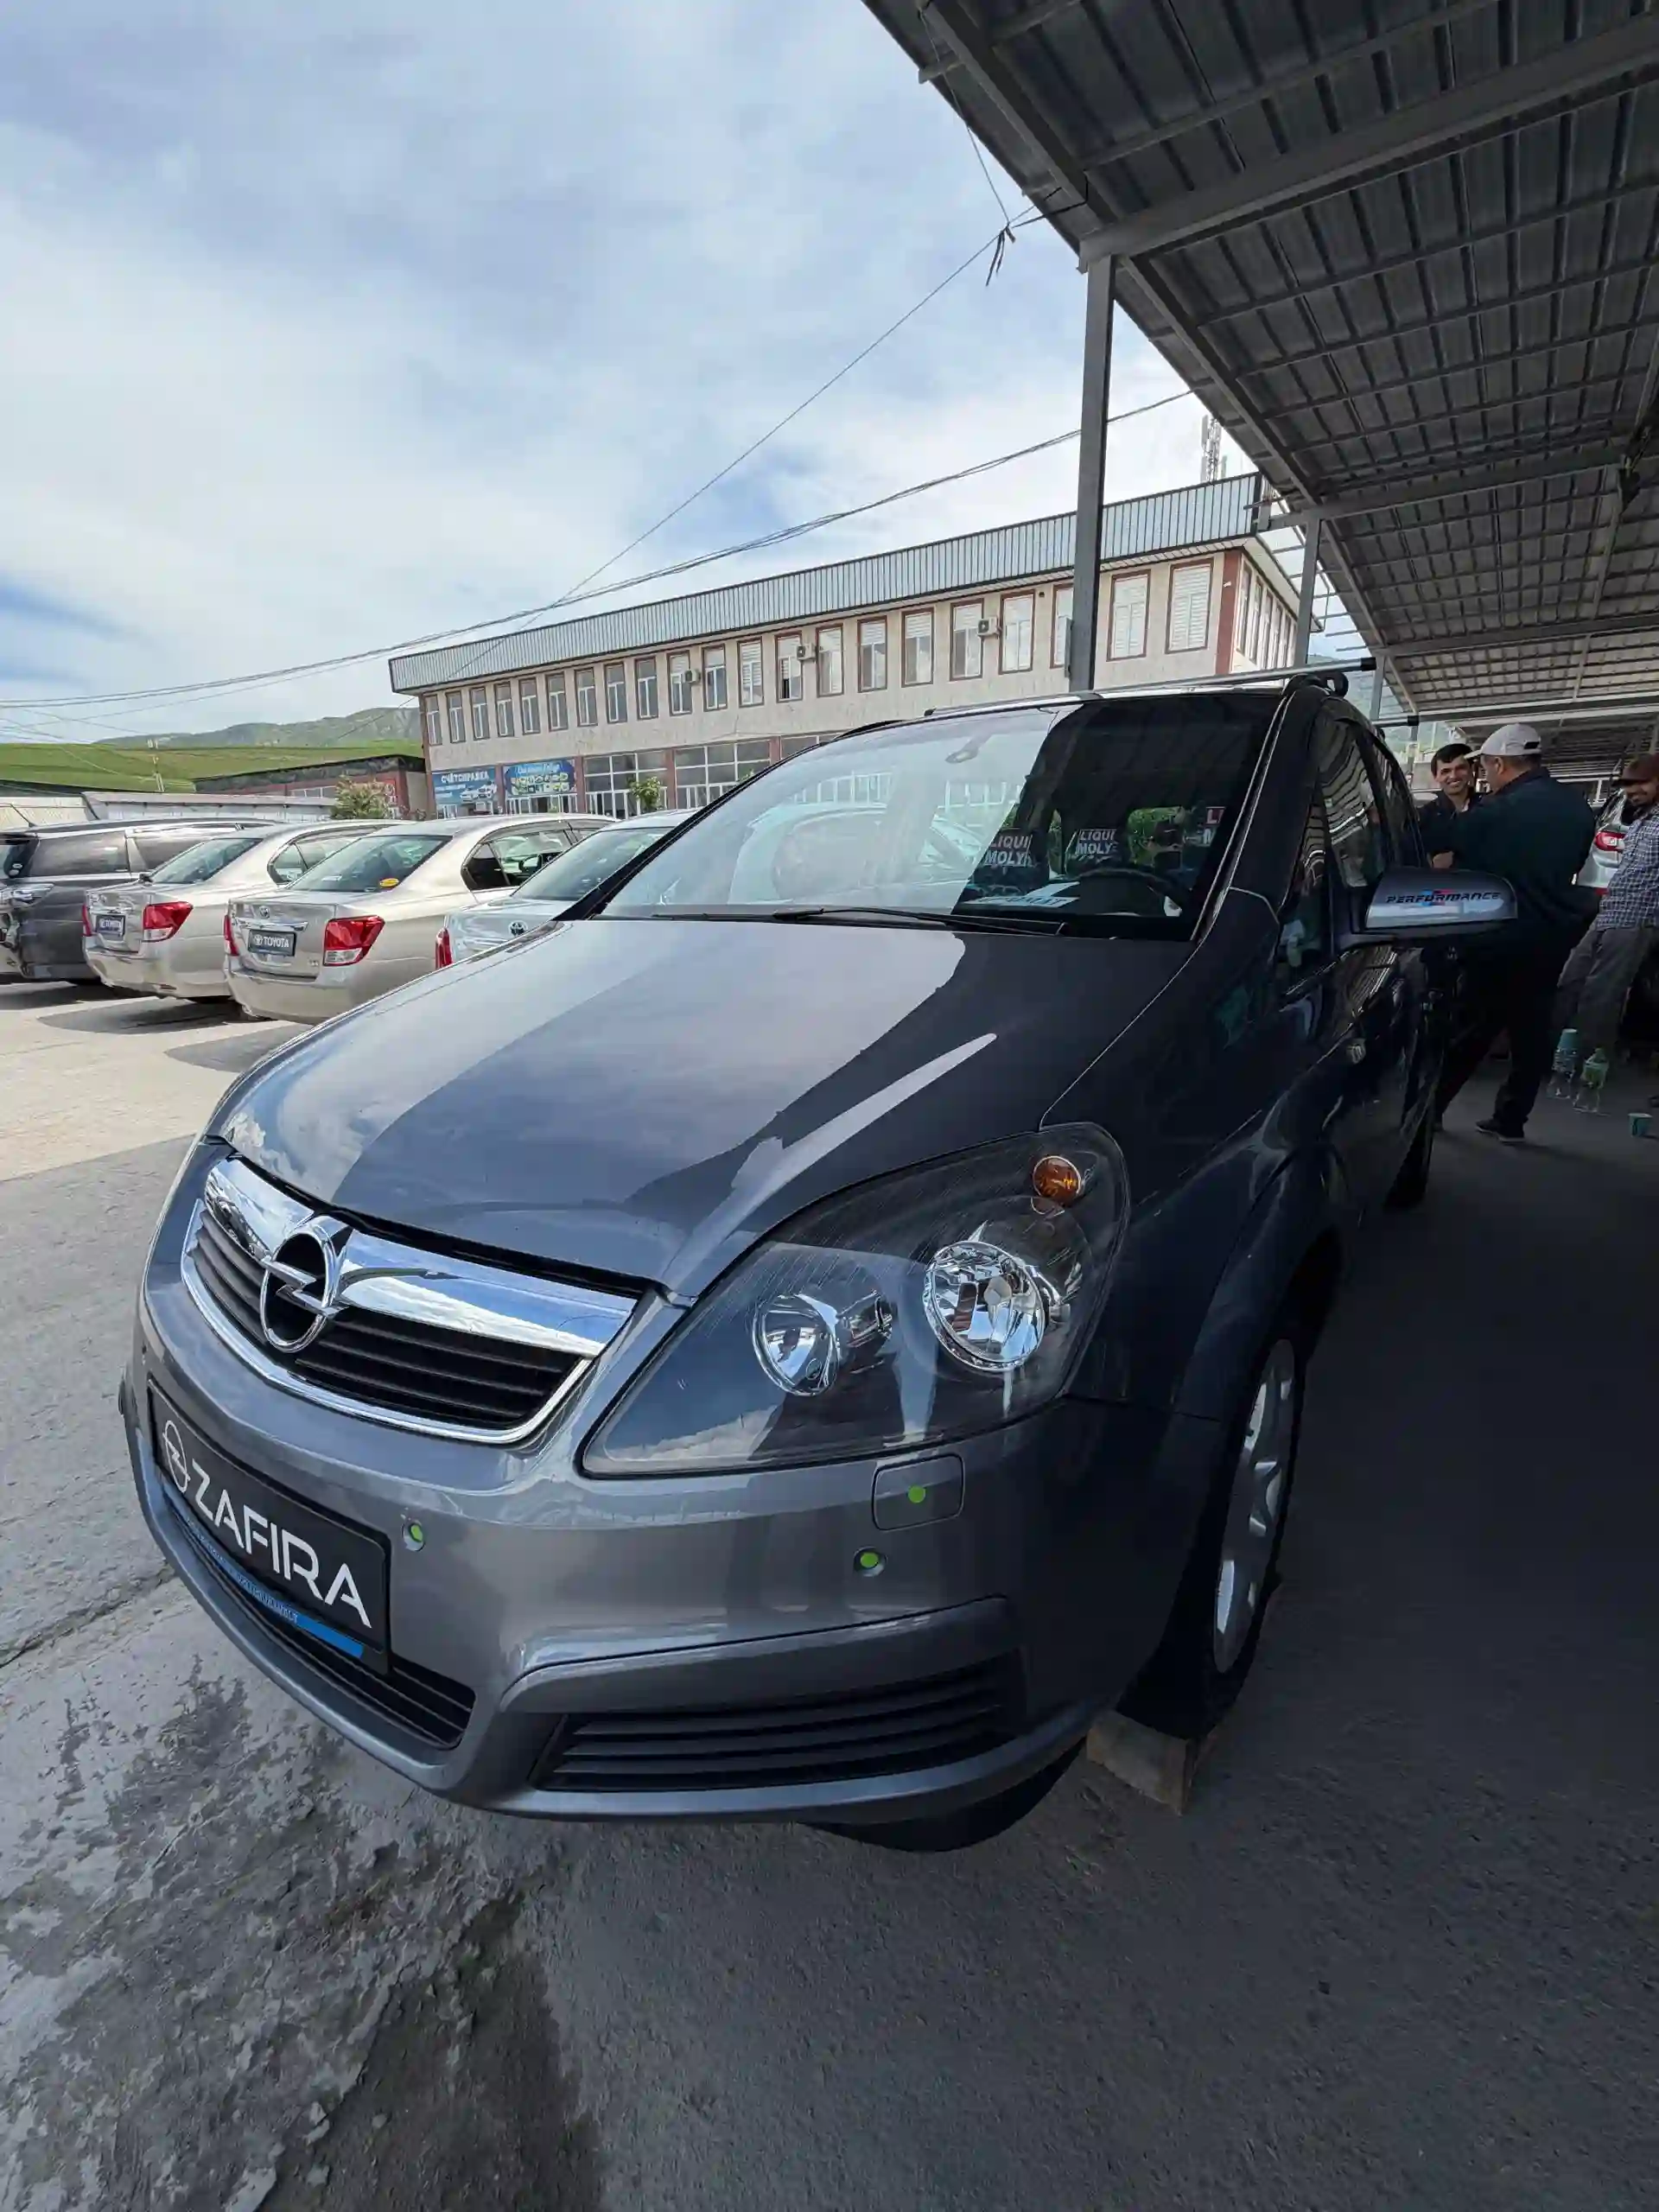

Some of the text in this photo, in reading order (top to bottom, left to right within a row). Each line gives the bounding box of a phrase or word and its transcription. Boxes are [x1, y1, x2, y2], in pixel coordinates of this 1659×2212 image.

[1080, 830, 1116, 841] LIQUI
[1075, 842, 1113, 855] MOLY
[985, 850, 1027, 865] MOLY
[1386, 891, 1502, 904] PERFORMANCE
[263, 936, 289, 948] TOYOTA
[192, 1458, 372, 1629] ZAFIRA
